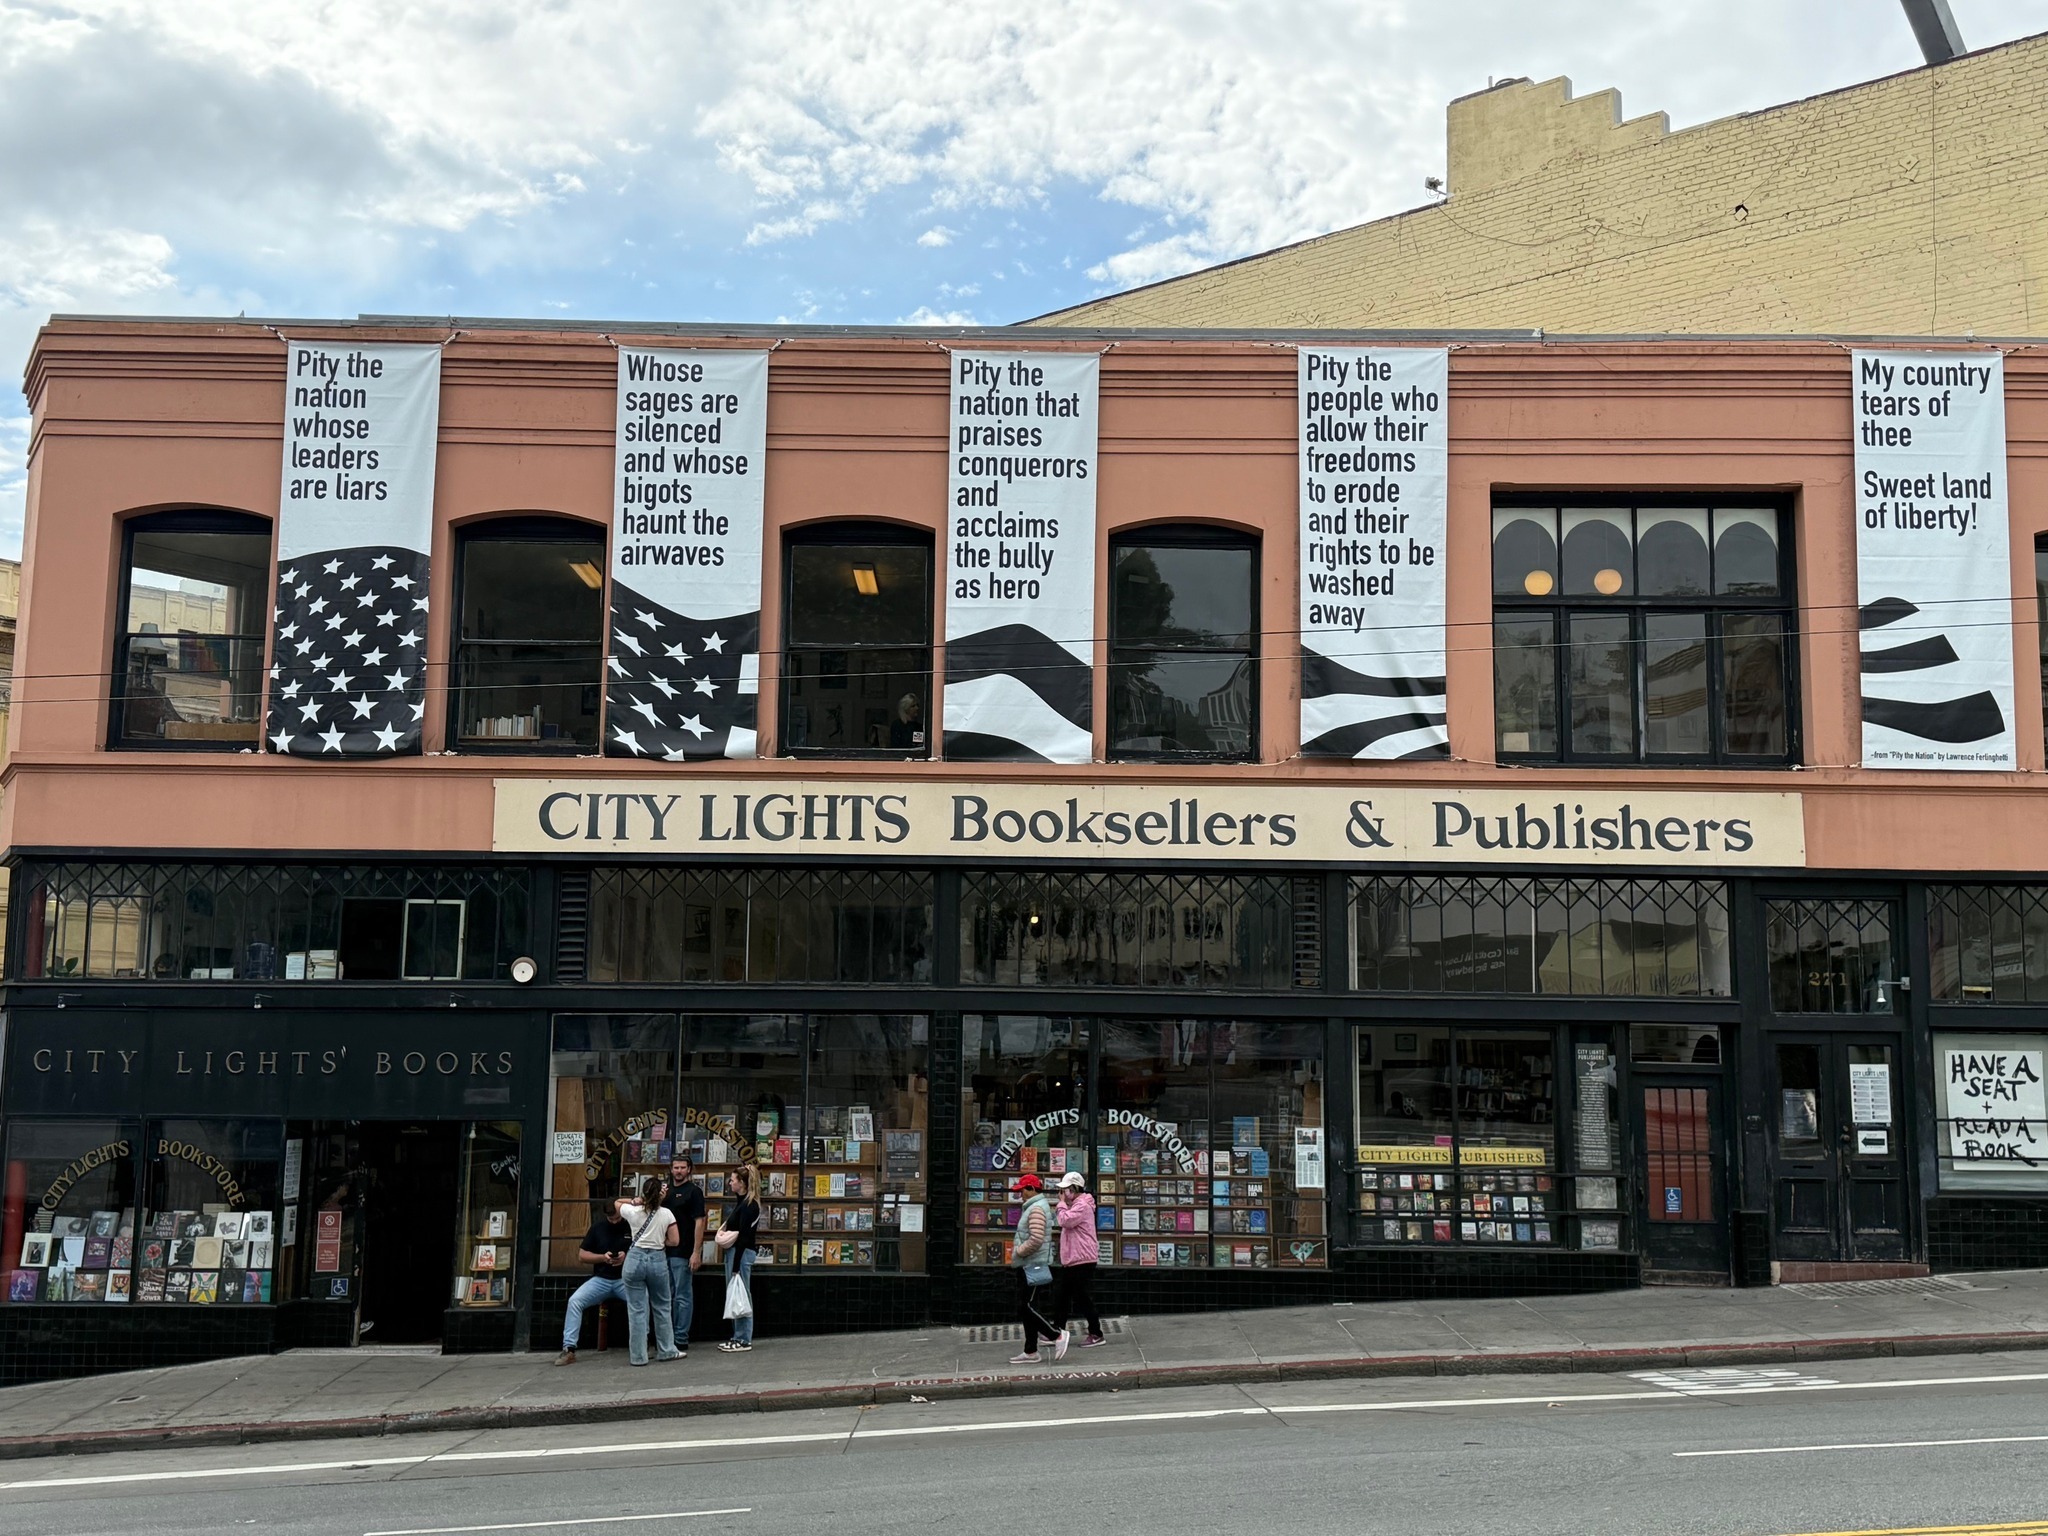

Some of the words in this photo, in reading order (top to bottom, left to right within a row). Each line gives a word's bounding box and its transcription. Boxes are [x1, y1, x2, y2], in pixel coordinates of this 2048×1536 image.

[296, 349, 340, 384] Pity
[347, 352, 383, 378] the
[627, 355, 703, 382] Whose
[959, 359, 1001, 392] Pity
[1008, 360, 1043, 387] the
[1307, 354, 1349, 387] Pity
[1356, 356, 1392, 381] the
[1861, 359, 1894, 392] My
[1904, 362, 1991, 393] country
[294, 382, 366, 409] nation
[626, 392, 693, 419] sages
[700, 392, 739, 414] are
[959, 390, 1028, 417] nation
[1036, 392, 1080, 418] that
[1307, 386, 1383, 418] people
[1391, 387, 1438, 411] who
[1861, 390, 1920, 416] tears
[1929, 390, 1950, 416] of
[293, 413, 369, 439] whose
[625, 419, 721, 445] silenced
[958, 420, 1042, 452] praises
[1306, 418, 1367, 442] allow
[1374, 416, 1428, 442] their
[1862, 420, 1911, 446] thee
[292, 443, 379, 470] leaders
[624, 450, 665, 473] and
[673, 453, 748, 476] whose
[958, 455, 1088, 483] conquerors
[1307, 447, 1416, 473] freedoms
[290, 479, 326, 500] are
[335, 475, 388, 500] liars
[623, 478, 692, 510] bigots
[957, 481, 998, 507] and
[1308, 478, 1325, 503] to
[1334, 477, 1400, 503] erode
[1864, 471, 1935, 498] Sweet
[1943, 472, 1991, 498] land
[622, 509, 685, 535] haunt
[693, 509, 728, 536] the
[957, 511, 1059, 538] acclaims
[1309, 508, 1347, 533] and
[1355, 508, 1409, 533] their
[1865, 502, 1886, 528] of
[1895, 502, 1977, 536] liberty!
[621, 540, 724, 566] airwaves
[956, 543, 990, 568] the
[999, 543, 1054, 575] bully
[1309, 539, 1371, 571] rights
[1379, 541, 1401, 565] to
[1408, 539, 1434, 565] be
[955, 579, 981, 599] as
[989, 574, 1040, 600] hero
[1309, 570, 1394, 596] washed
[1309, 604, 1365, 632] away
[1938, 753, 1945, 761] by
[1976, 754, 2008, 762] Ferlinghetti
[538, 791, 681, 841] CITY
[699, 794, 910, 843] LIGHTS
[950, 795, 1297, 847] Booksellers
[1346, 800, 1394, 848] &
[1433, 800, 1754, 852] Publishers
[1809, 972, 1847, 986] 271
[34, 1049, 137, 1073] CITY
[376, 1052, 512, 1075] BOOKS
[1951, 1054, 2007, 1083] HAVE
[2014, 1055, 2039, 1082] A
[1964, 1077, 2026, 1101] SEAT
[992, 1134, 1023, 1170] CITY
[1019, 1108, 1080, 1141] LIGHTS
[1108, 1109, 1197, 1174] BOOKSTORE
[1955, 1117, 2010, 1137] READ
[2017, 1117, 2036, 1143] A
[584, 1140, 612, 1181] CITY
[609, 1108, 668, 1147] LIGHTS
[1361, 1150, 1393, 1161] CITY
[1397, 1150, 1448, 1162] LIGHTS
[1963, 1139, 2038, 1167] BOOK
[42, 1170, 76, 1210] CITY
[70, 1140, 129, 1177] LIGHTS
[158, 1139, 245, 1207] BOOKSTORE
